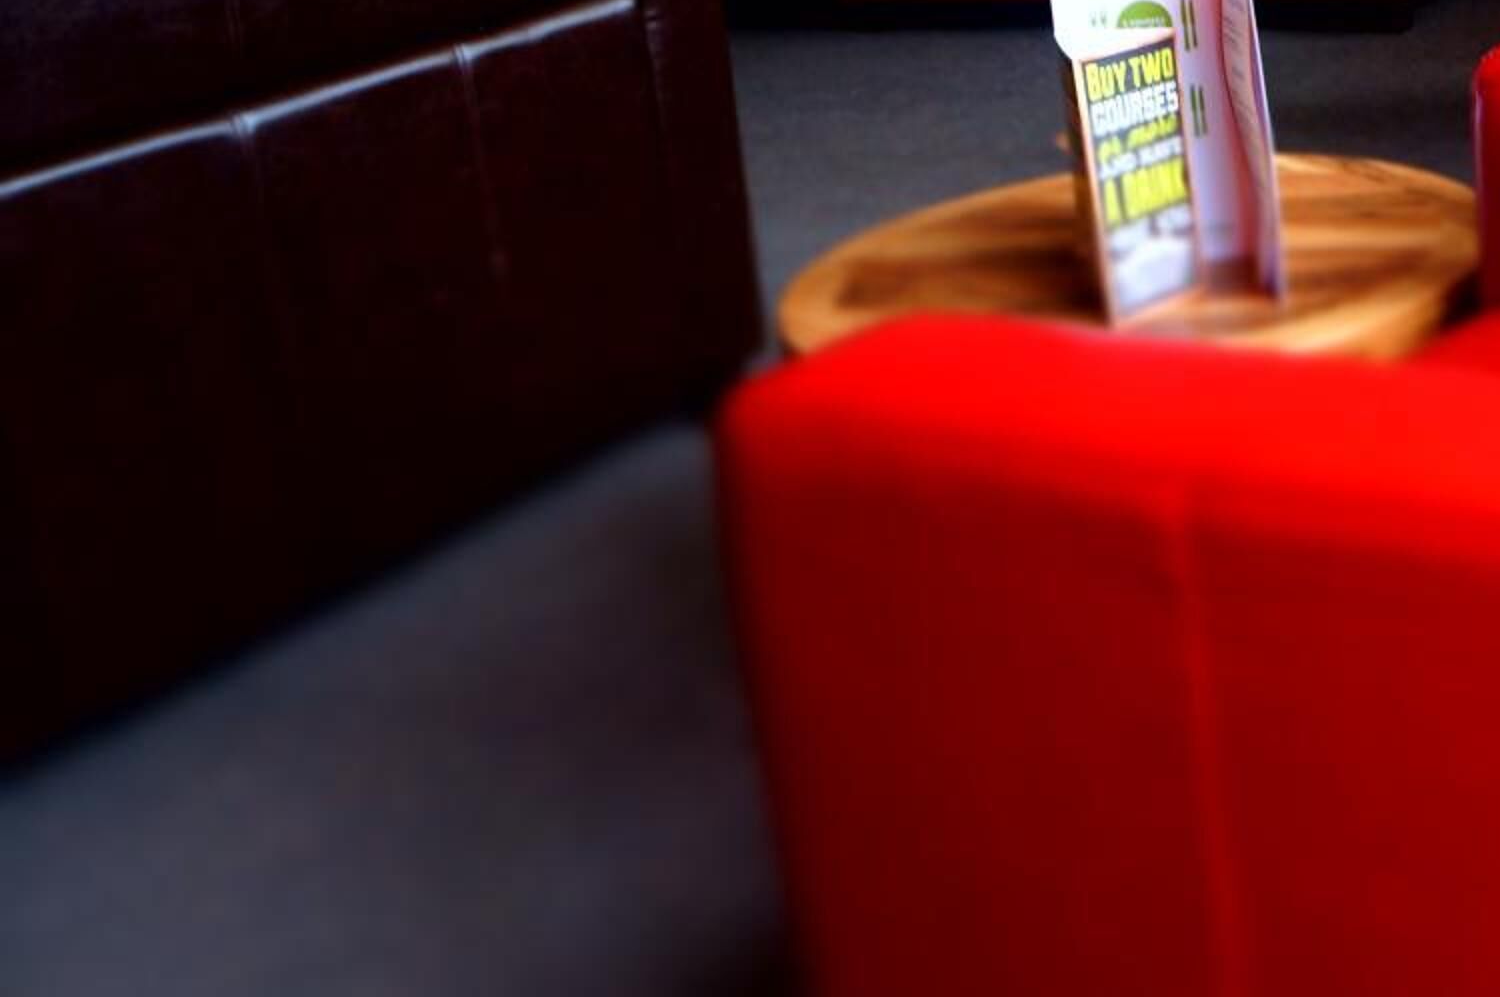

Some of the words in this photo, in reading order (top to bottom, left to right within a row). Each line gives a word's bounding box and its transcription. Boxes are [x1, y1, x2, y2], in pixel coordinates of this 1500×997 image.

[1085, 60, 1126, 102] BUY
[1128, 47, 1174, 89] TWO
[1090, 80, 1179, 137] COURSES
